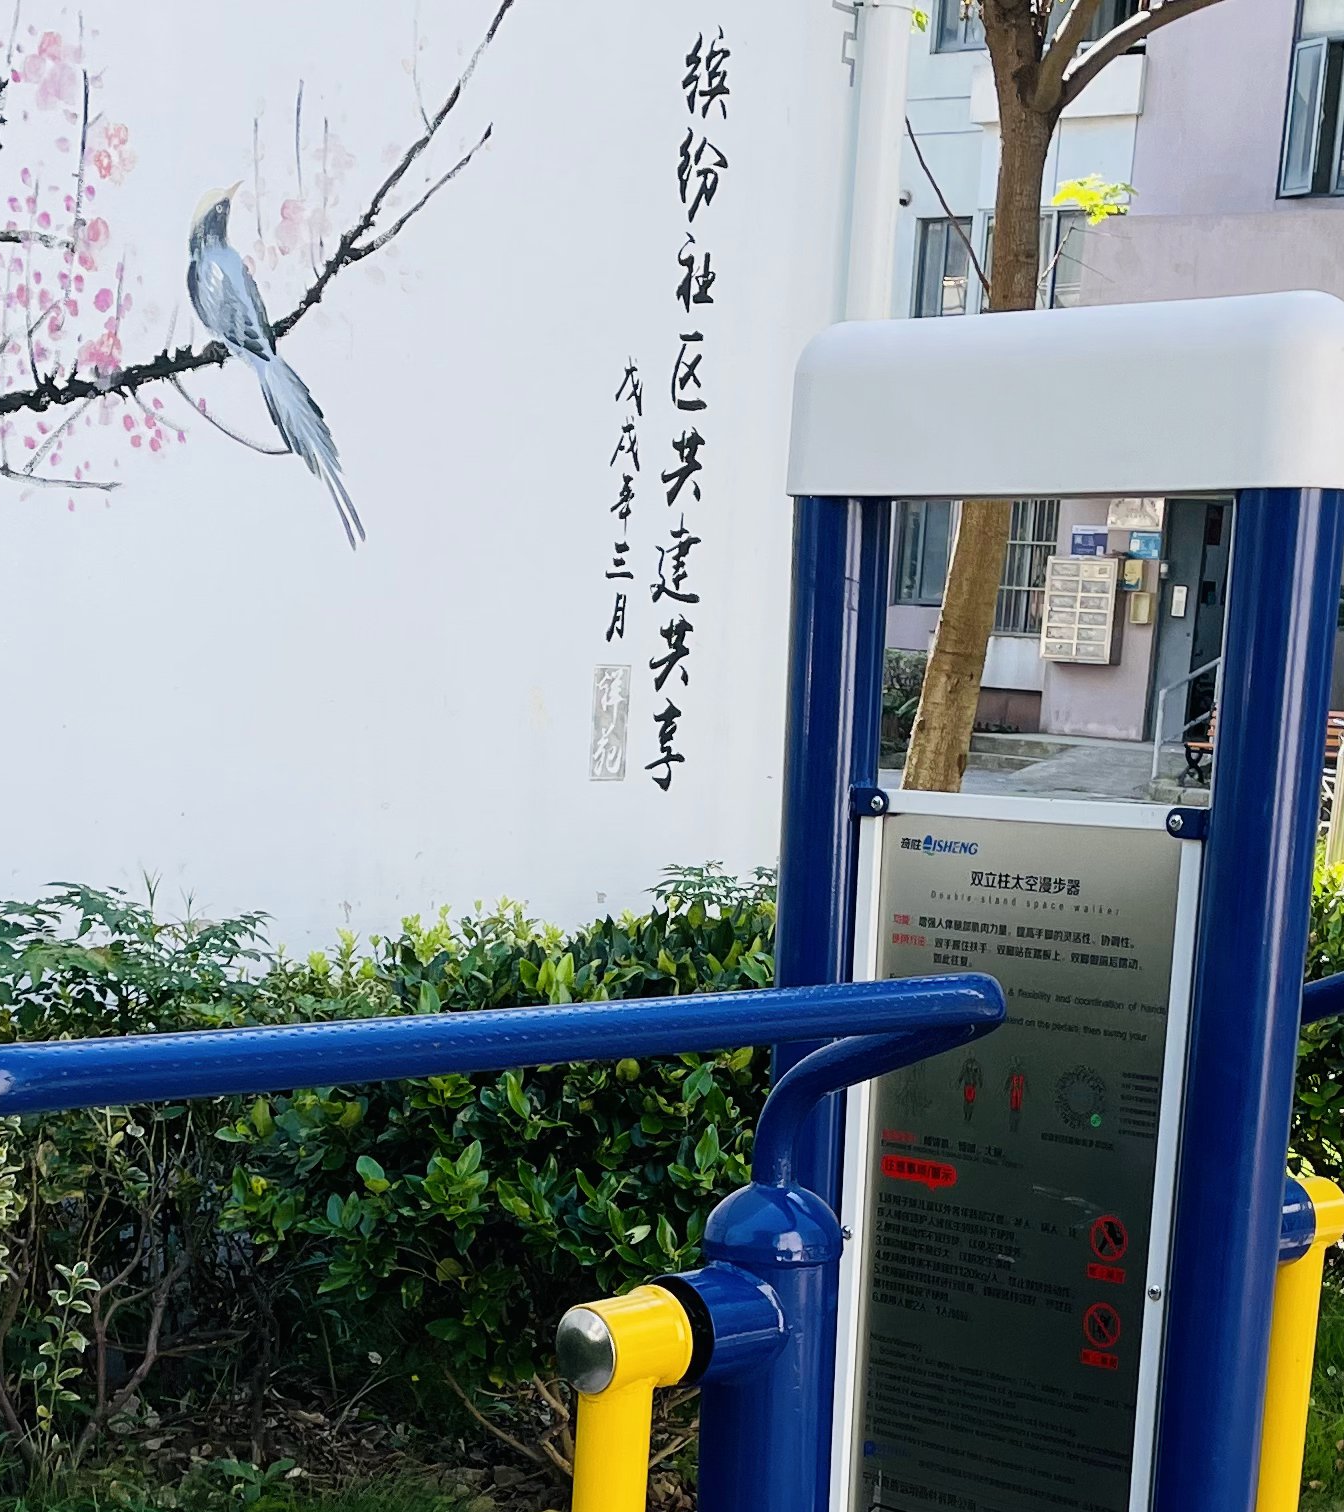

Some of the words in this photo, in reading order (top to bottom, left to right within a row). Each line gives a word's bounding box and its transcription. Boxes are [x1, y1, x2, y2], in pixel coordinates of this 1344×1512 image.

[644, 25, 731, 792] 缤纷社区共建共享
[604, 357, 644, 643] 戊戌年三月
[970, 870, 1081, 896] 双立柱太空漫步器
[1026, 900, 1064, 911] space
